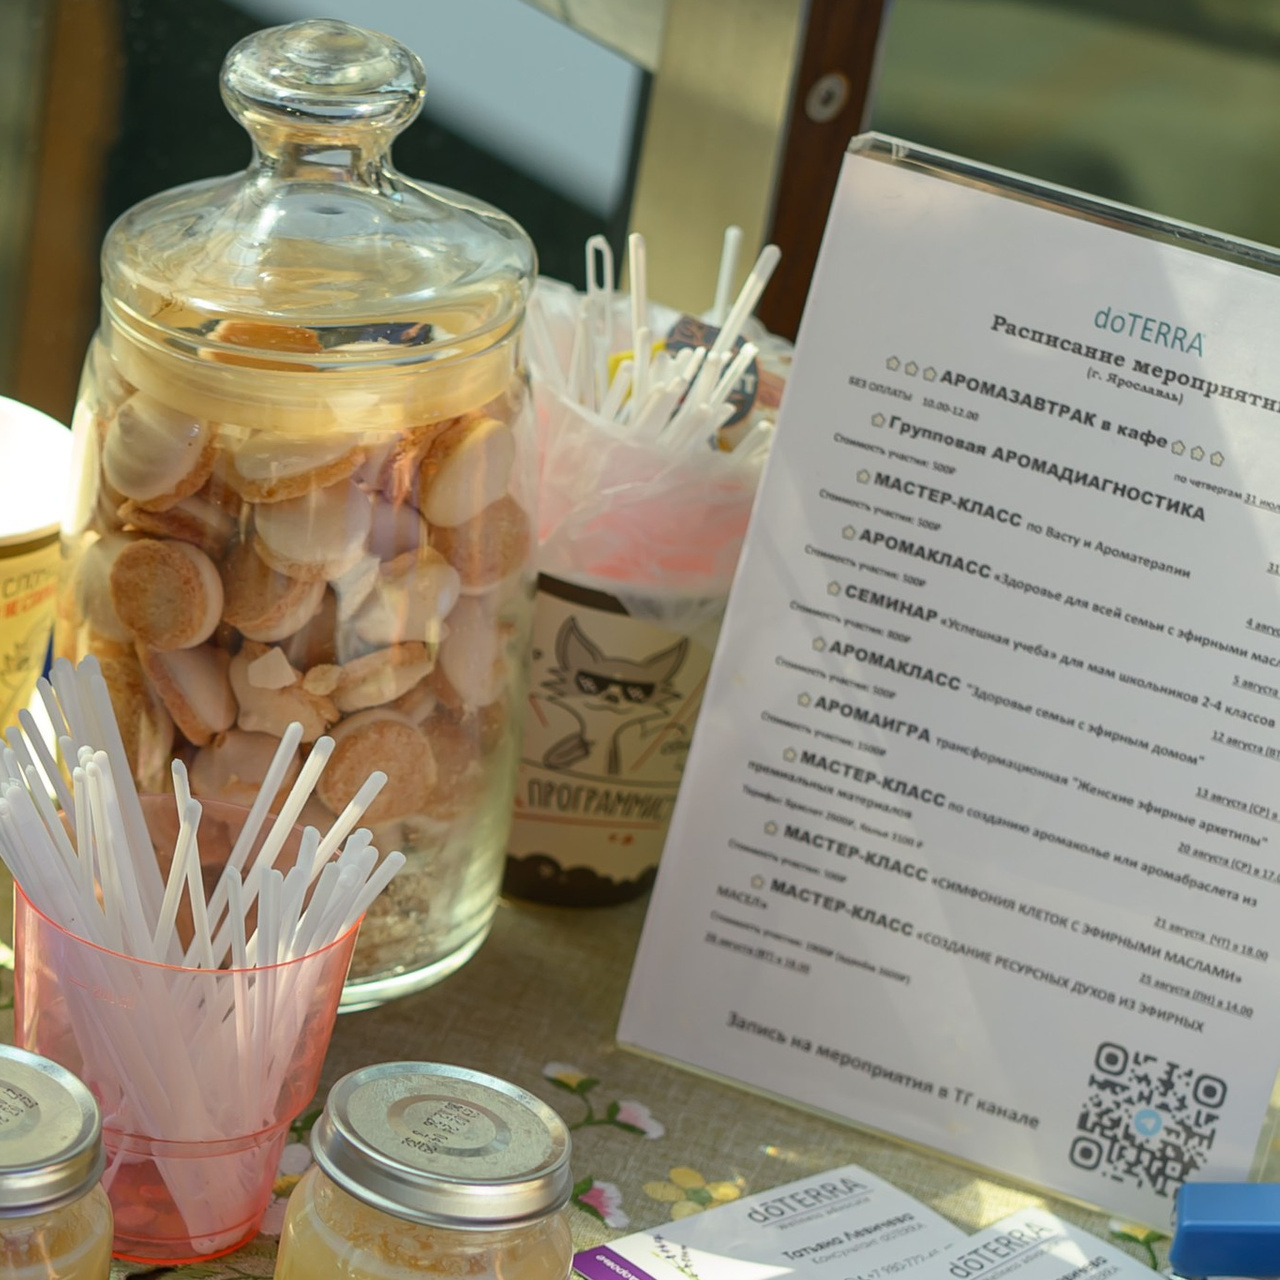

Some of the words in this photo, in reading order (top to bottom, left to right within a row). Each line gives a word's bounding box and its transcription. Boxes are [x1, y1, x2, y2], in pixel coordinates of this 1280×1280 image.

[989, 313, 1126, 368] Расписание
[1092, 305, 1203, 358] doTERRA
[847, 374, 868, 390] БЕЗ
[867, 380, 913, 402] ОПЛАТЫ
[921, 396, 980, 422] 10.00-12.00
[938, 369, 1097, 428] АРОМАЗАВТРАК
[1099, 419, 1112, 432] в
[1115, 423, 1168, 449] кафе
[1085, 365, 1103, 381] (г.
[1104, 371, 1184, 406] Ярославль)
[887, 414, 987, 456] Групповая
[989, 445, 1205, 522] АРОМАДИАГНОСТИКА
[1172, 472, 1188, 484] по
[1188, 477, 1243, 500] четвергам
[1242, 491, 1257, 506] 31
[872, 470, 1023, 528] МАСТЕР-КЛАСС
[1025, 521, 1044, 535] по
[1044, 524, 1081, 548] Васту
[1081, 538, 1092, 549] и
[1093, 539, 1191, 579] Ароматерапии
[857, 527, 992, 579] АРОМАКЛАСС
[992, 572, 1063, 602] «Здоровье
[1062, 594, 1090, 610] для
[1090, 602, 1123, 620] всей
[1123, 612, 1165, 633] семьи
[1166, 625, 1175, 636] с
[1175, 628, 1249, 658] эфирными
[1245, 616, 1254, 629] 4
[843, 583, 939, 622] СЕМИНАР
[939, 616, 1011, 647] «Успешная
[1011, 639, 1058, 660] учеба»
[1057, 654, 1085, 669] для
[1085, 662, 1116, 679] мам
[1117, 672, 1199, 705] школьников
[1200, 694, 1223, 712] 2-4
[1223, 704, 1276, 729] классов
[827, 639, 961, 691] АРОМАКЛАСС
[965, 682, 1033, 714] "Здоровье
[1034, 706, 1076, 727] семьи
[1076, 719, 1086, 731] с
[1086, 723, 1150, 750] эфирным
[1149, 743, 1206, 766] домом"
[813, 695, 931, 744] АРОМАИГРА
[935, 736, 1069, 786] трансформационная
[1071, 775, 1135, 807] "Женские
[1136, 799, 1197, 827] эфирные
[1197, 819, 1269, 847] архетипы"
[1210, 729, 1225, 744] 12
[1224, 735, 1264, 755] августа
[746, 759, 835, 795] премиальных
[835, 788, 913, 820] материалов
[1208, 792, 1248, 812] августа
[1247, 801, 1271, 819] (СР)
[798, 749, 947, 808] МАСТЕР-КЛАСС
[946, 800, 965, 815] по
[965, 806, 1031, 835] созданию
[1030, 827, 1111, 861] аромаколье
[1112, 853, 1139, 869] или
[1139, 862, 1240, 902] аромабраслета
[1241, 894, 1258, 908] из
[1176, 840, 1192, 855] 20
[1190, 847, 1230, 868] августа
[1229, 857, 1253, 875] (СР)
[782, 823, 928, 882] МАСТЕР-КЛАСС
[930, 876, 1016, 911] «СИМФОНИЯ
[1016, 902, 1069, 929] КЛЕТОК
[1069, 918, 1081, 933] С
[1080, 922, 1162, 959] ЭФИРНЫМИ
[1162, 949, 1243, 984] МАСЛАМИ»
[1167, 922, 1206, 942] августа
[768, 876, 914, 937] МАСТЕР-КЛАСС
[915, 931, 993, 965] «СОЗДАНИЕ
[993, 954, 1070, 989] РЕСУРСНЫХ
[1069, 979, 1116, 1005] ДУХОВ
[1117, 995, 1137, 1011] ИЗ
[1137, 1001, 1205, 1034] ЭФИРНЫХ
[1152, 978, 1191, 998] августа
[725, 1010, 787, 1045] Запись
[789, 1035, 813, 1053] на
[814, 1043, 934, 1094] мероприятия
[936, 1085, 949, 1100] в
[954, 1086, 974, 1106] ТГ
[975, 1098, 1040, 1130] канале
[782, 1236, 844, 1261] Татьяна
